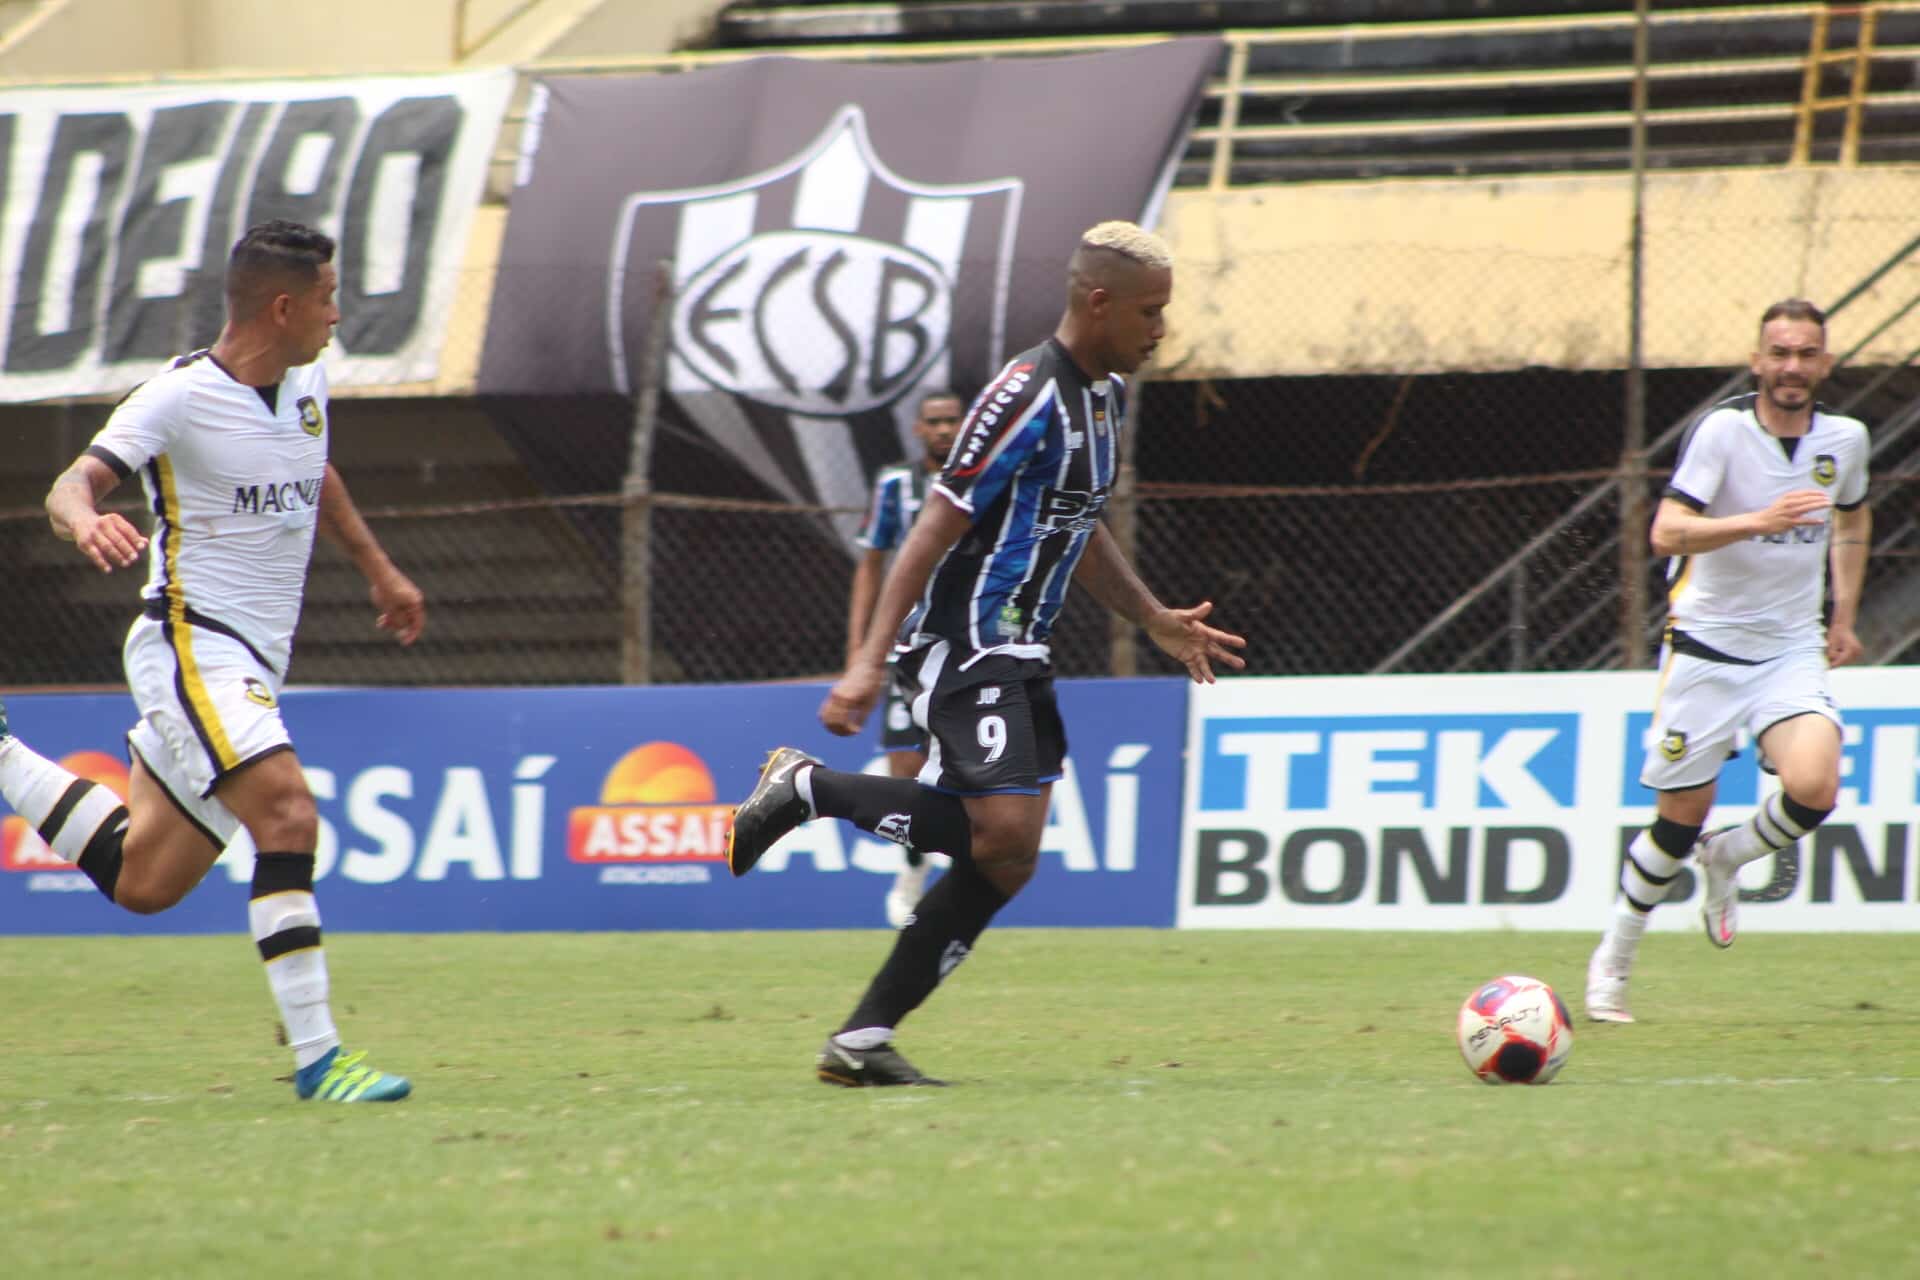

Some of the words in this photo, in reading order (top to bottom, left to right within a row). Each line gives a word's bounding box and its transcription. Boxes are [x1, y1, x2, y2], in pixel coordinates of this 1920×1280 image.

[686, 245, 938, 405] ECSB
[959, 371, 1031, 467] PHYSICUS
[976, 715, 1008, 763] 9
[1217, 728, 1561, 809] TEK
[582, 810, 727, 858] ASSAÍ
[1194, 825, 1572, 906] BOND
